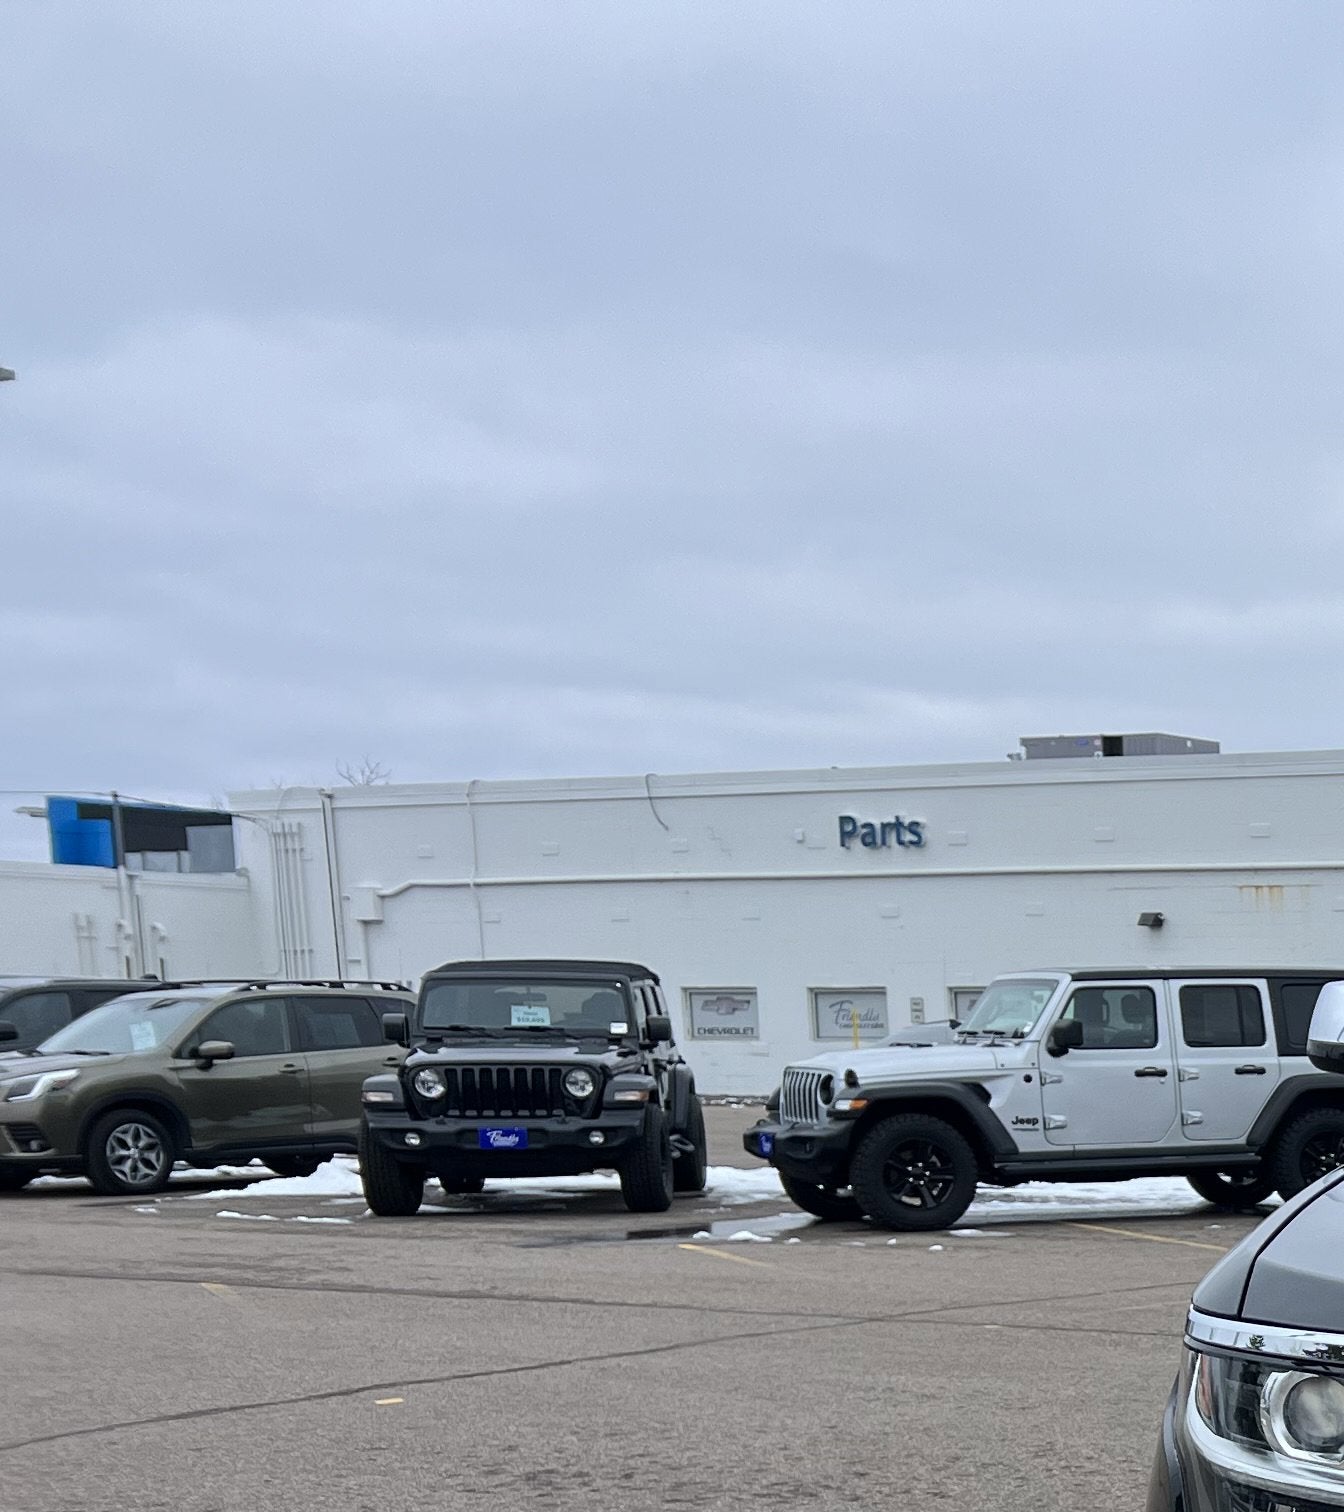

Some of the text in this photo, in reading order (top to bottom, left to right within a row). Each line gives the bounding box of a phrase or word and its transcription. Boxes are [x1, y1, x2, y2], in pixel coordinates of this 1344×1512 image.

[838, 815, 923, 848] Parts
[697, 1026, 754, 1035] CHEVROLET
[1011, 1115, 1039, 1126] Jeep
